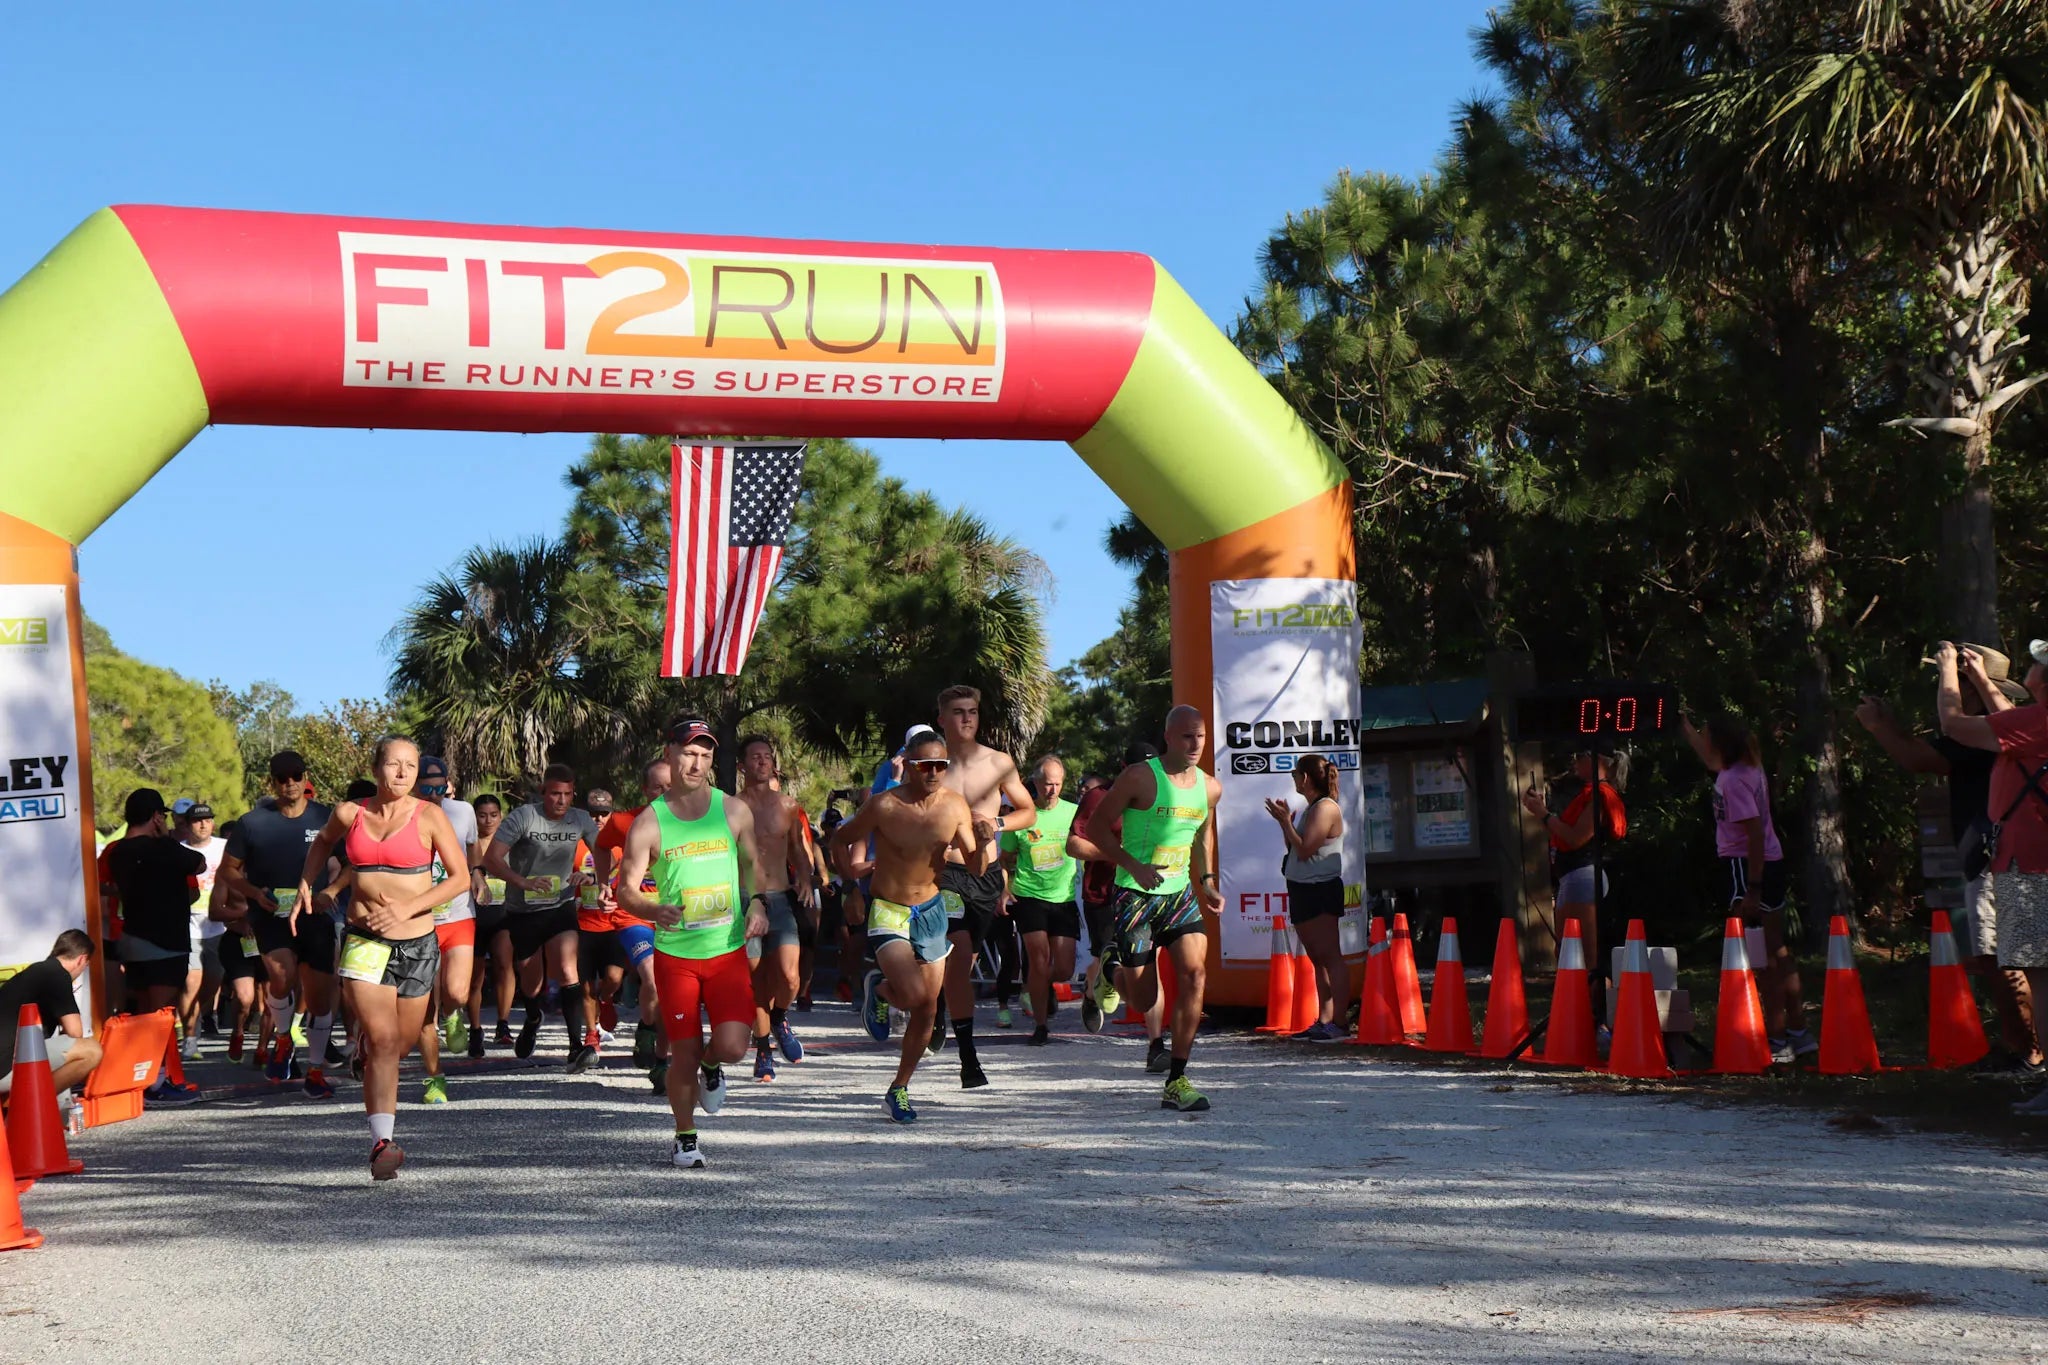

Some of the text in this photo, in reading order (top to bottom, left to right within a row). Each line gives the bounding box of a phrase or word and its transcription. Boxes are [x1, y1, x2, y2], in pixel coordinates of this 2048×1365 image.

[353, 251, 984, 356] FIT2RUN
[355, 359, 993, 396] THE RUNNER'S SUPERSTORE
[1233, 603, 1352, 629] FIT2TIME
[1226, 718, 1362, 749] CONLEY
[1275, 752, 1358, 770] SARU
[529, 831, 577, 842] ROGUE
[664, 838, 728, 859] FIT2RUN
[1159, 850, 1184, 867] 704
[689, 892, 726, 913] 700
